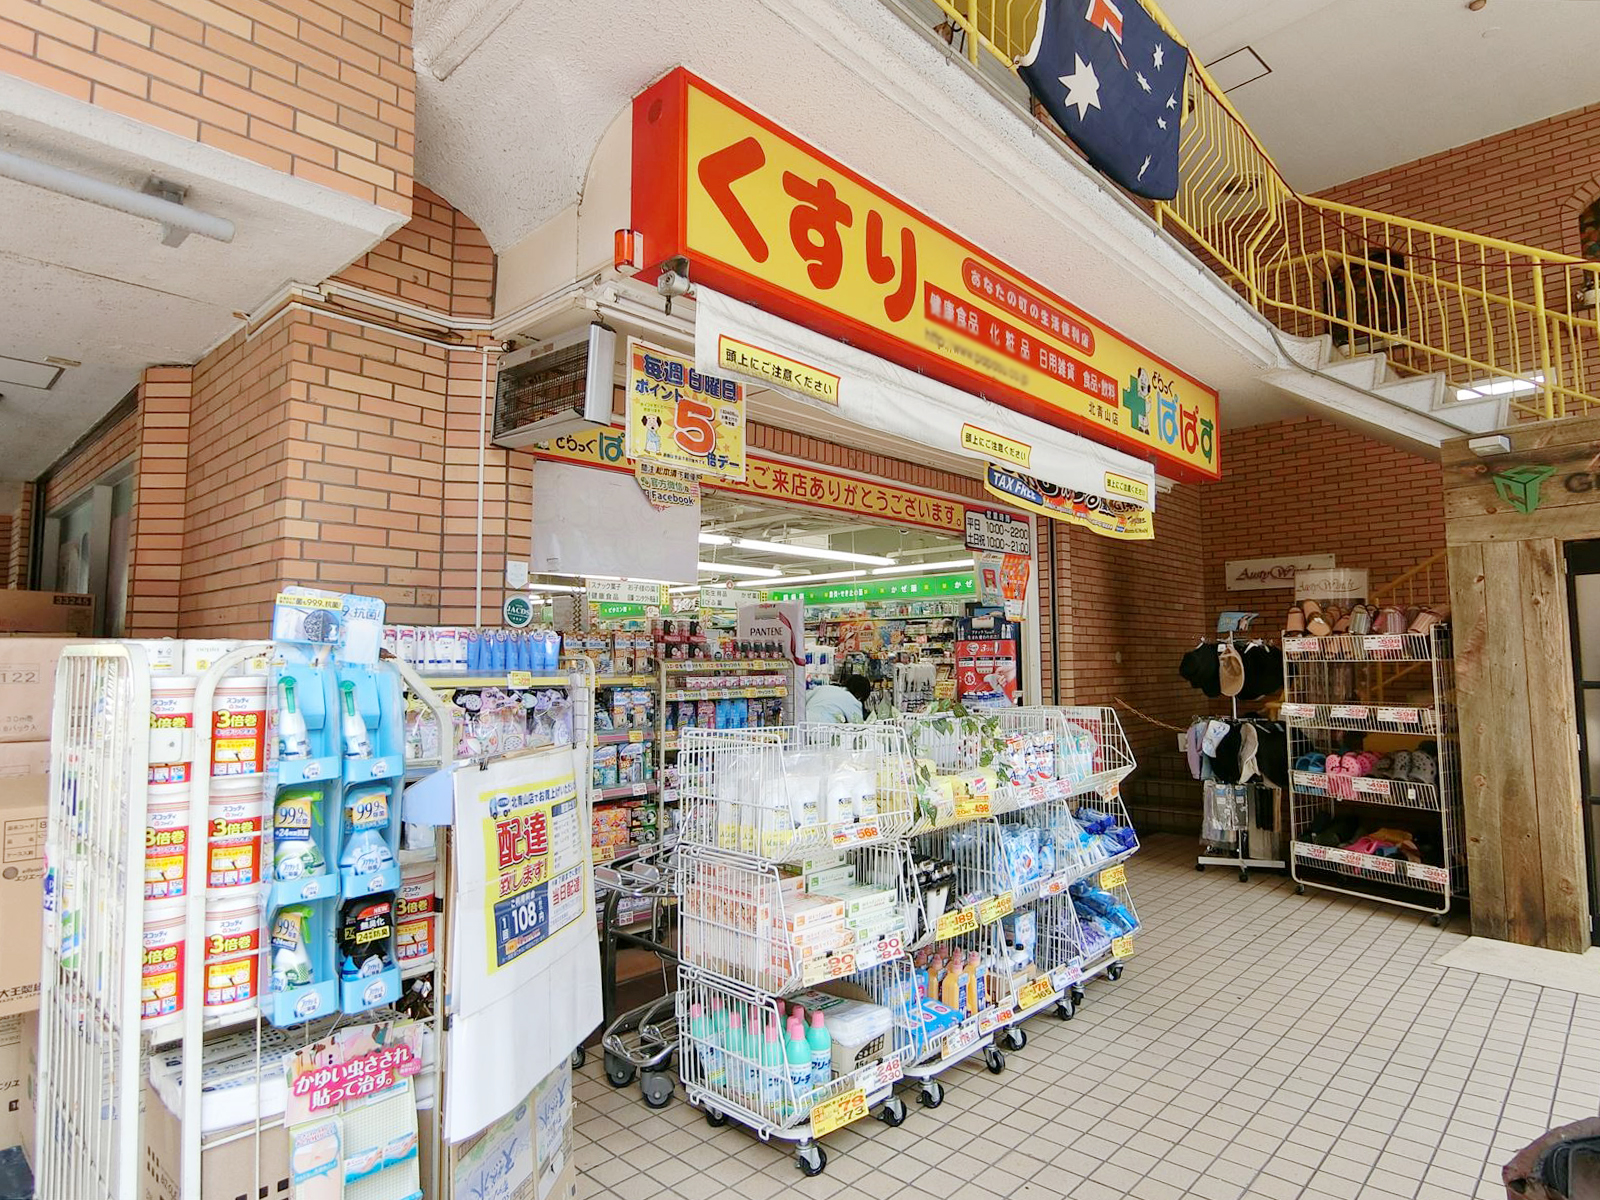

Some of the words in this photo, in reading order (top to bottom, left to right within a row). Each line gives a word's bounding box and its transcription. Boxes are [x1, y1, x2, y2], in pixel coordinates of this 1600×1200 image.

[698, 136, 917, 323] くすり
[970, 269, 1090, 349] あなたの町の生活便利店
[930, 292, 979, 334] 健康食品
[989, 323, 1031, 360] 化粧品
[1039, 348, 1076, 383] 日用雑貨
[644, 354, 684, 387] 毎週
[689, 368, 738, 403] 日曜日
[725, 348, 833, 396] 頭上にご注意ください
[636, 378, 684, 403] ポイント
[1088, 402, 1119, 426] 北青山店
[674, 397, 716, 457] 5
[1157, 392, 1214, 464] ぱぱす
[965, 433, 1027, 460] 頭上にご注意ください
[993, 472, 1016, 491] TAX
[652, 490, 695, 505] Facebook
[967, 517, 981, 531] 平日
[750, 627, 784, 636] PANTENE
[216, 709, 258, 728] 3倍巻
[212, 818, 254, 837] 3倍巻
[856, 826, 878, 839] 568
[496, 811, 549, 870] 配達
[396, 898, 428, 916] 3倍巻
[512, 901, 537, 934] 108
[209, 934, 251, 954] 3倍巻
[877, 938, 899, 952] 90
[827, 954, 854, 968] 90
[830, 964, 853, 976] 84
[296, 1048, 409, 1094] かゆい虫さされ
[877, 1059, 900, 1077] 248
[880, 1070, 900, 1083] 230
[312, 1071, 393, 1107] 貼って治す。
[838, 1094, 864, 1111] 78
[844, 1106, 864, 1120] 73
